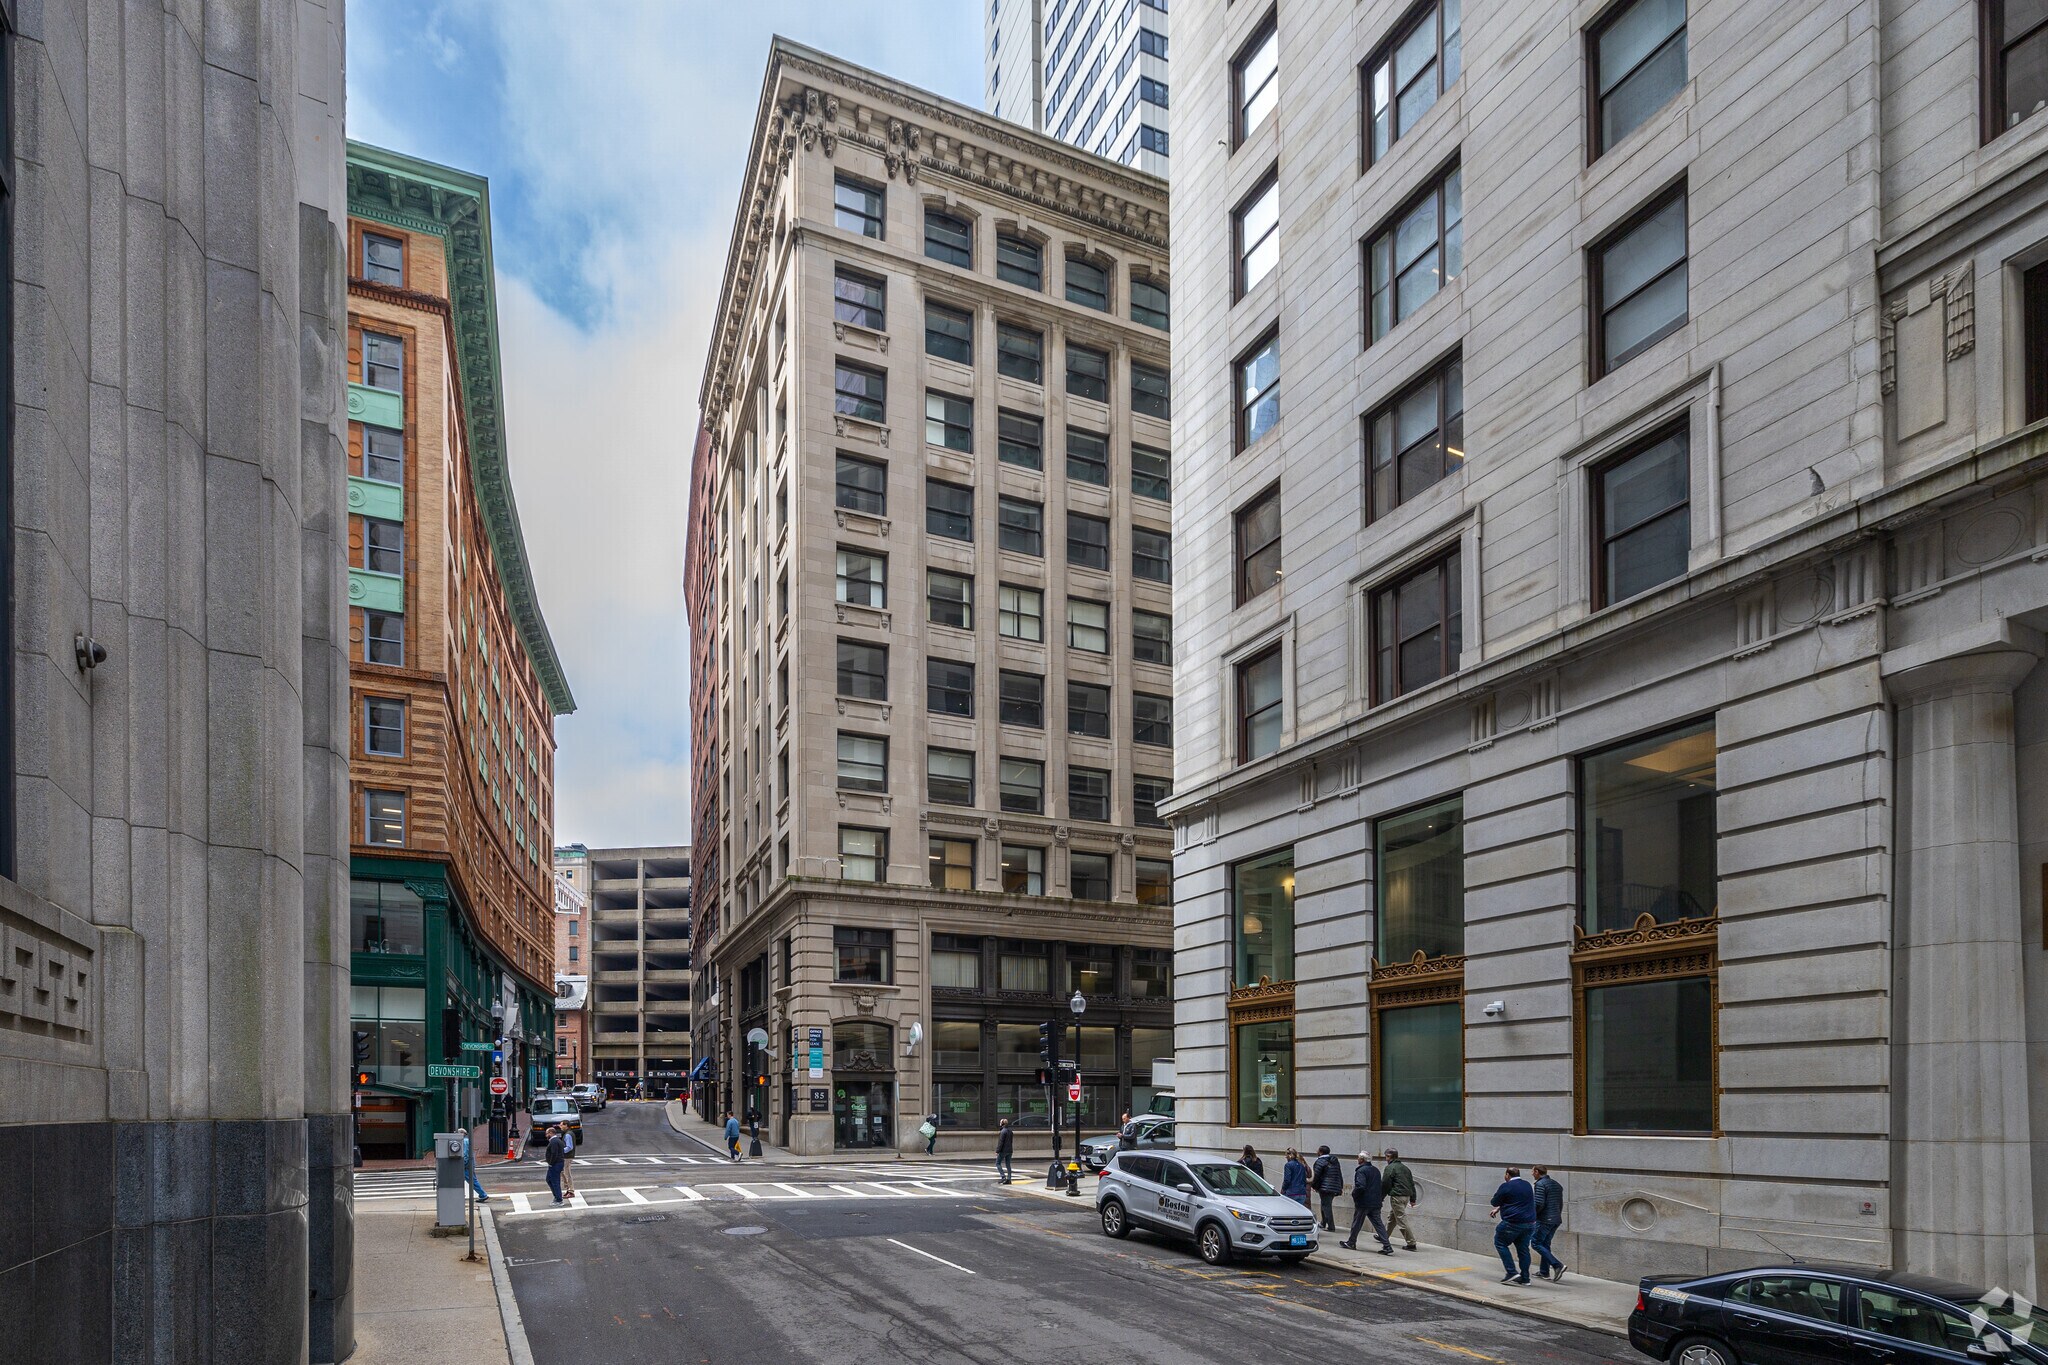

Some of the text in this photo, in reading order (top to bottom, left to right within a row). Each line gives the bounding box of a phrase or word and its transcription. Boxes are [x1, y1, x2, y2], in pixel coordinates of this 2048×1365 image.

[430, 1066, 470, 1077] DEVONSHIRE
[814, 1091, 825, 1100] 85
[1164, 1197, 1190, 1213] Boston
[1157, 1206, 1190, 1219] PUBLIC WORKS
